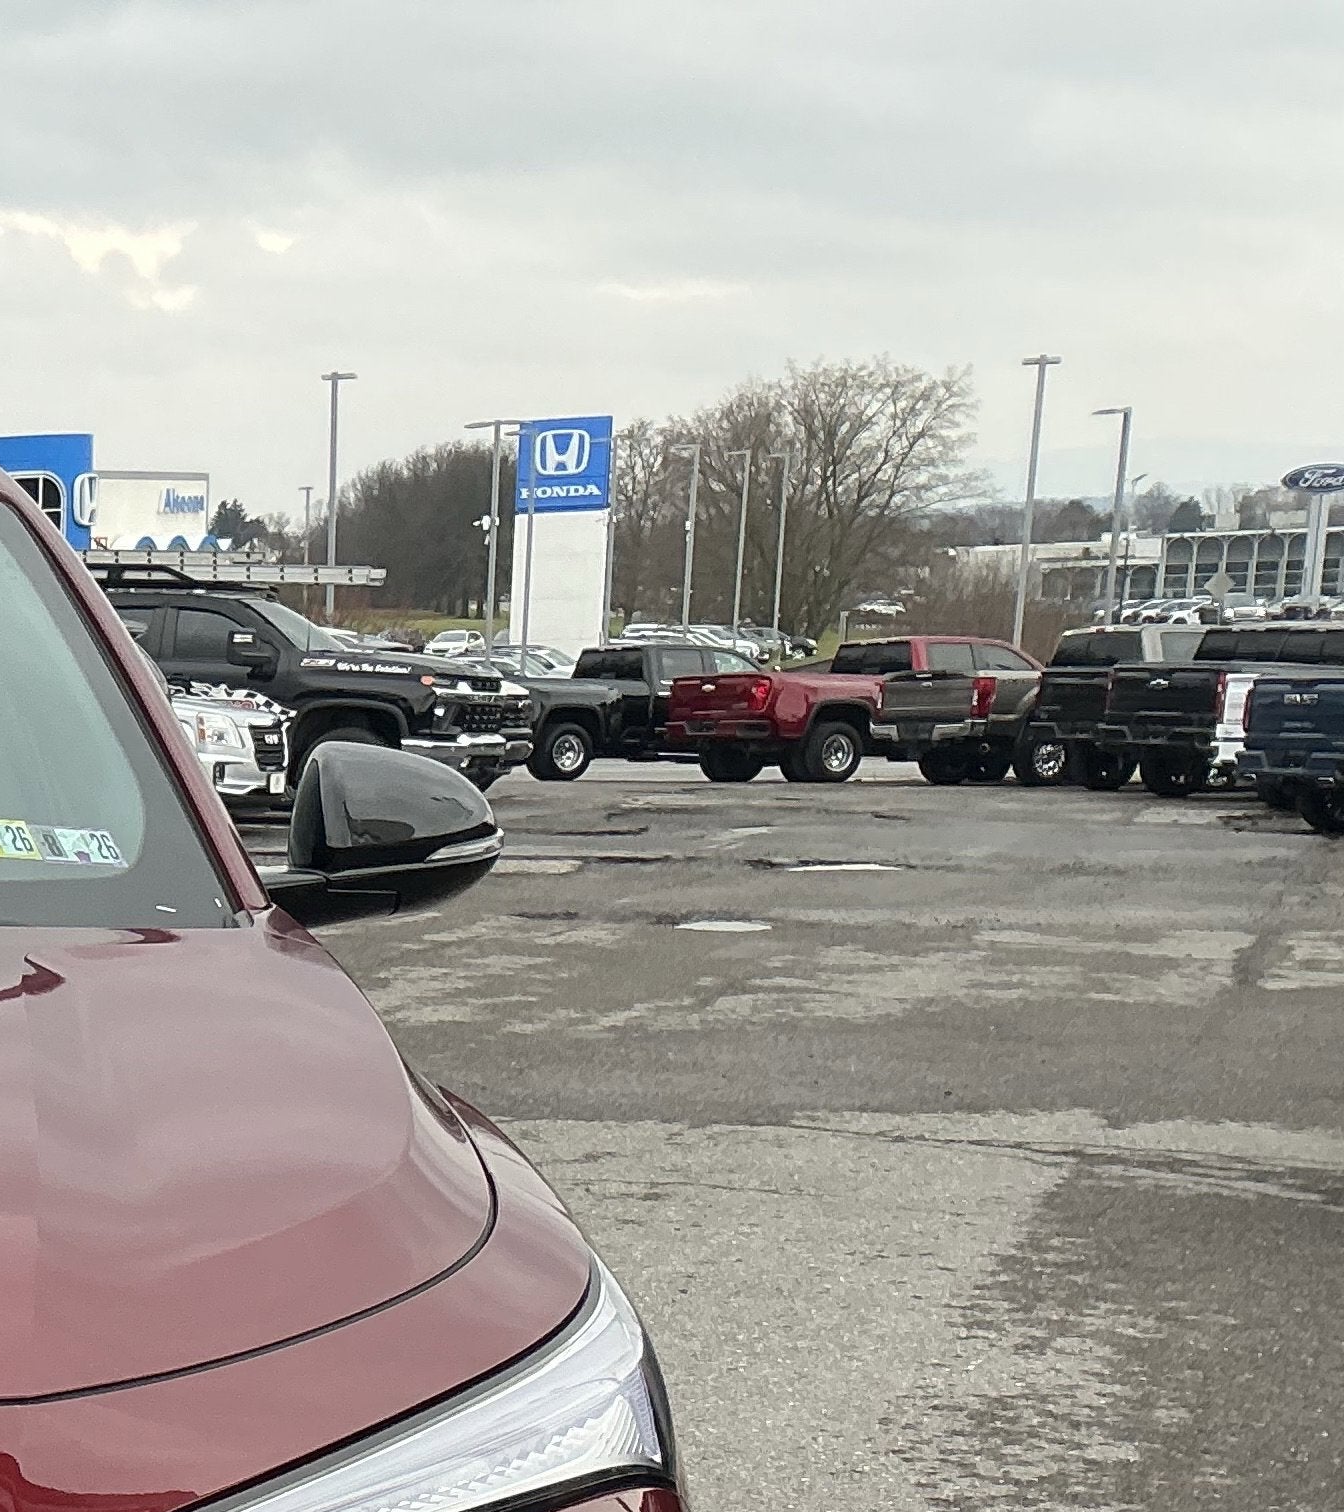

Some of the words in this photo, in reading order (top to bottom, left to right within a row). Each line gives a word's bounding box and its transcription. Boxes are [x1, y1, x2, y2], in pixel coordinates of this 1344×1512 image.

[519, 484, 602, 499] HONDA
[5, 825, 34, 852] 26
[42, 832, 63, 858] 8
[89, 832, 120, 860] 26
